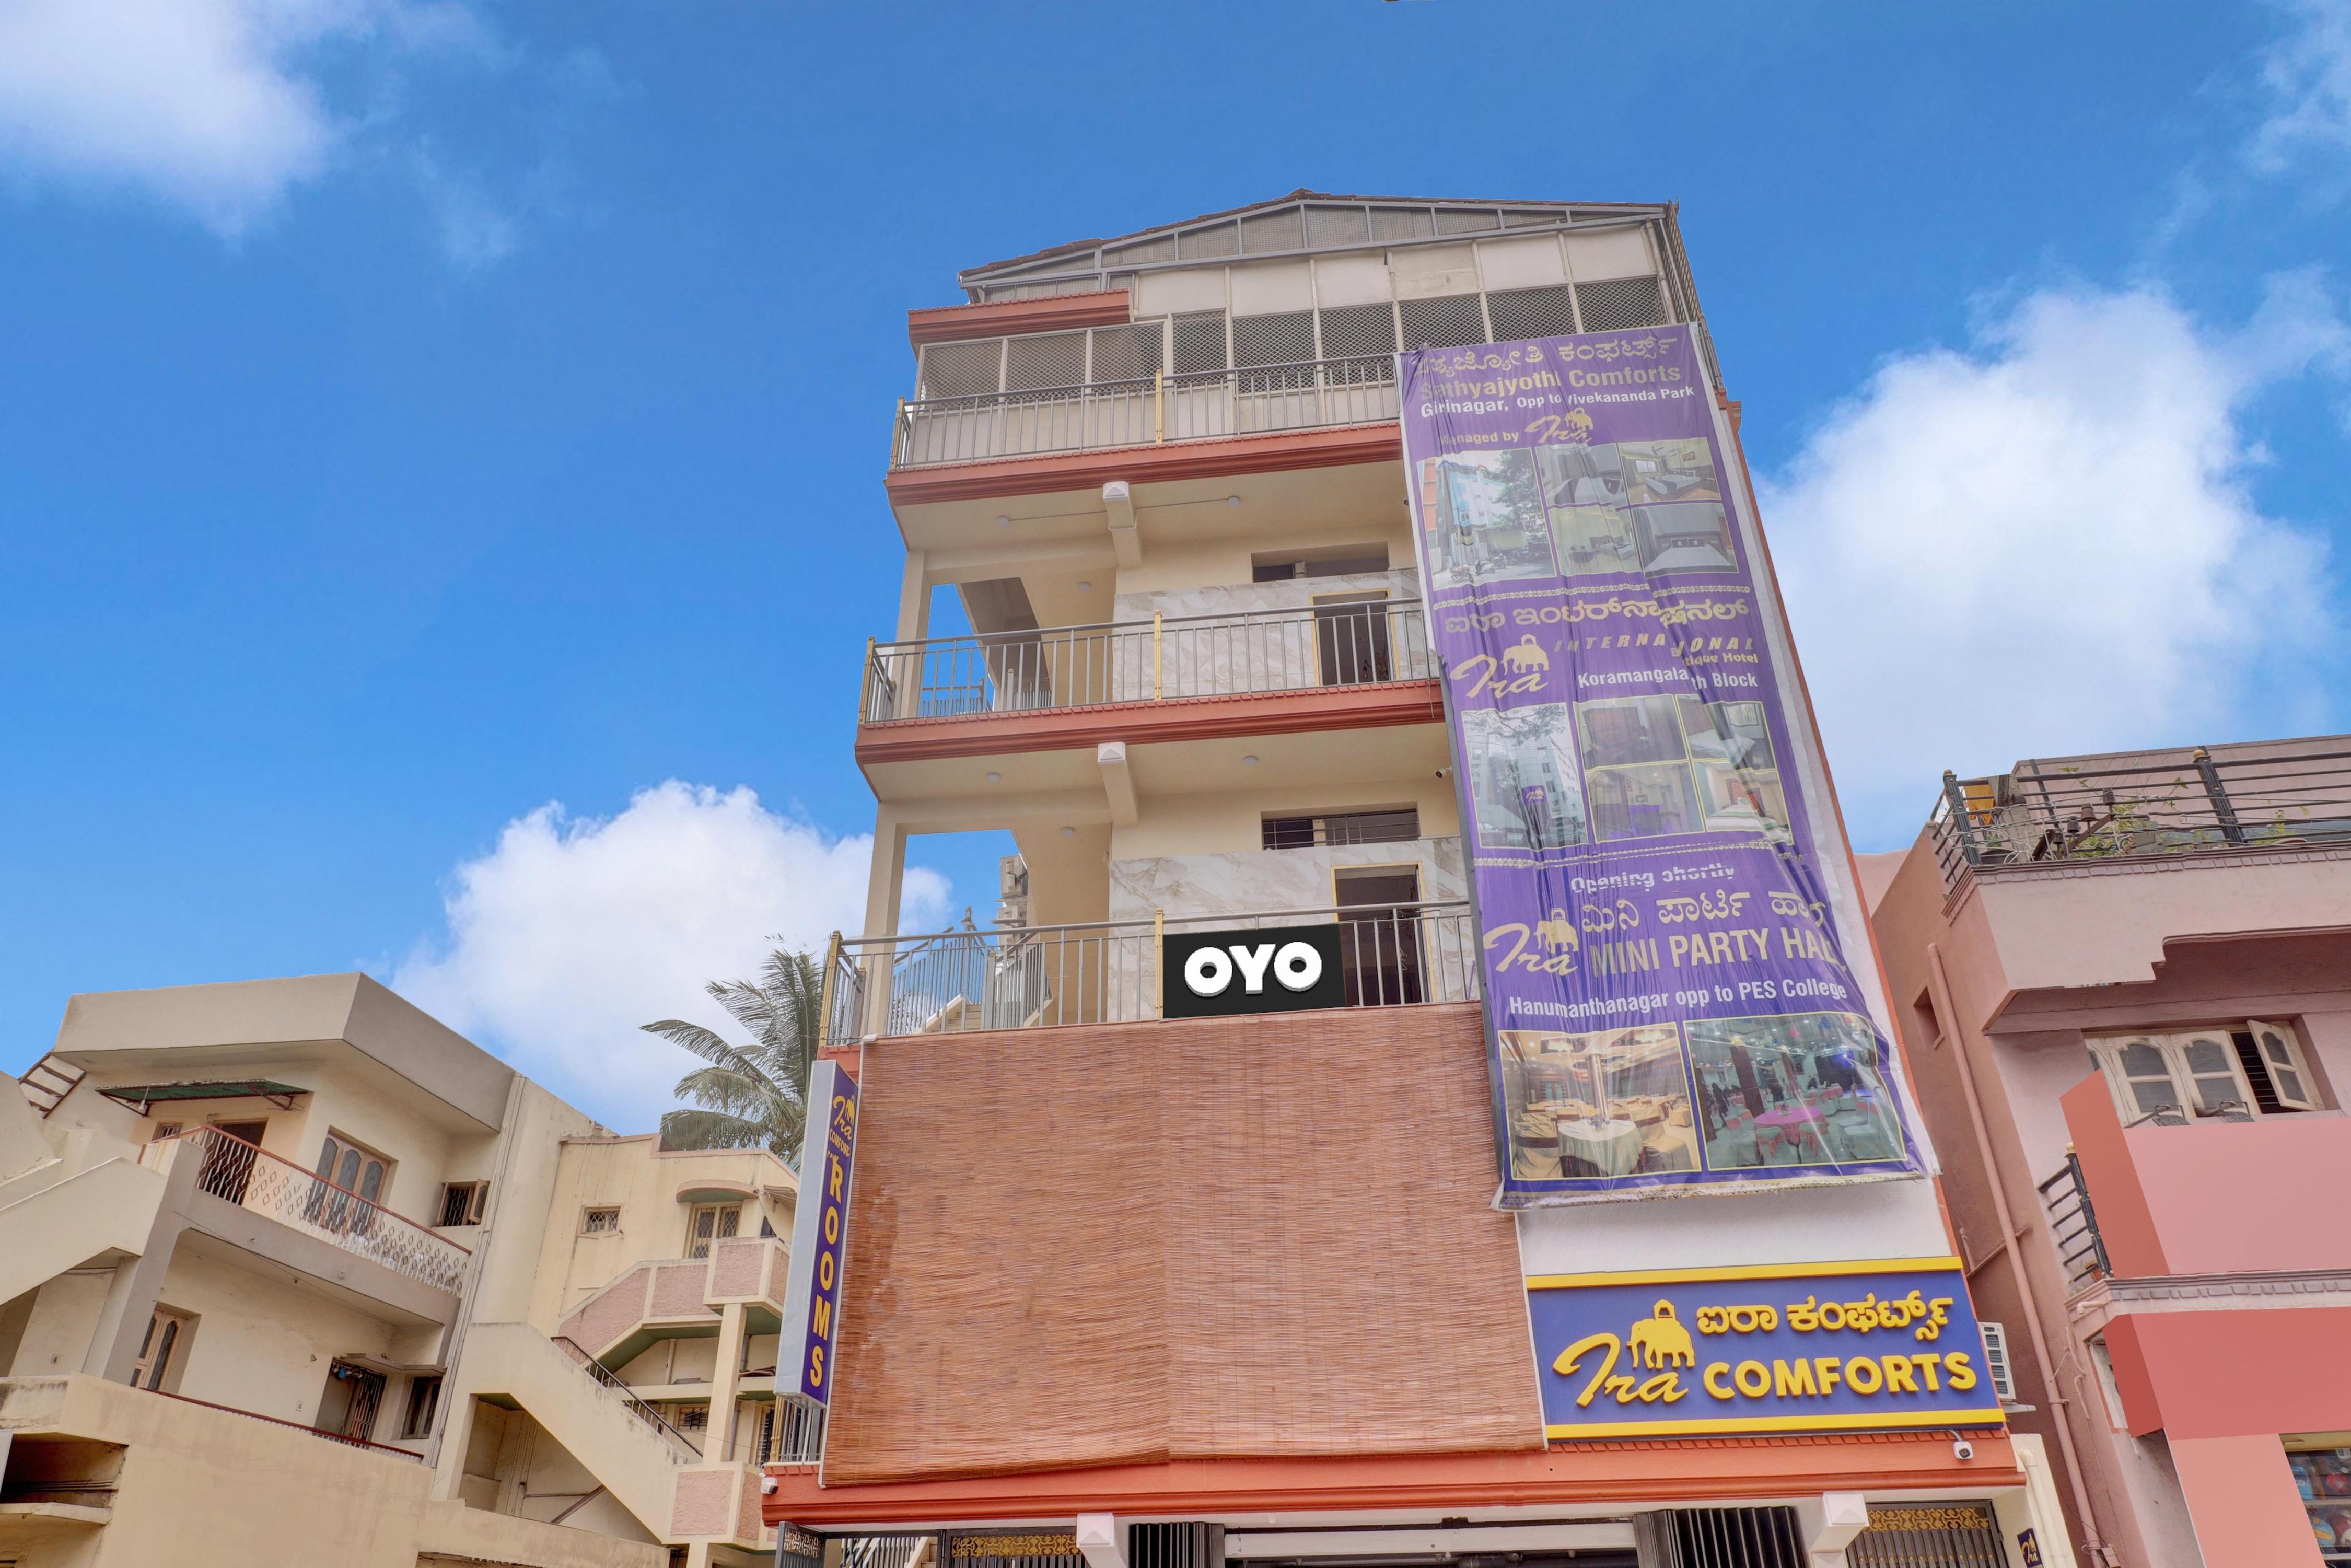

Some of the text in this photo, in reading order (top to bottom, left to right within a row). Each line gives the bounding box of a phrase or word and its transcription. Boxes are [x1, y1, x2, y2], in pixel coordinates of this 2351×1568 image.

[1569, 365, 1682, 387] Comforts
[1421, 399, 1509, 417] Girinagar,
[1517, 396, 1545, 409] Opp
[1548, 394, 1562, 404] to
[1660, 386, 1695, 399] Park
[1502, 431, 1519, 443] by
[1554, 633, 1754, 655] INTERNAIONAL
[1722, 653, 1758, 663] Hotel
[1449, 653, 1548, 698] Ira
[1578, 667, 1759, 690] Koramangala th Block
[1570, 872, 1655, 894] Opening
[1581, 899, 1639, 933] ಮಿನಿ
[1483, 922, 1578, 977] Ira
[1590, 938, 1660, 977] MINI
[1668, 927, 1769, 968] PARTY
[1184, 942, 1322, 997] OYO
[1509, 977, 1847, 1018] Hanumanthanagar opp to PES College
[810, 1156, 843, 1387] ROOMS
[1696, 1304, 1778, 1335] ಐರಾ
[1552, 1332, 1689, 1407] Ira
[1702, 1352, 1977, 1400] COMFORTS
